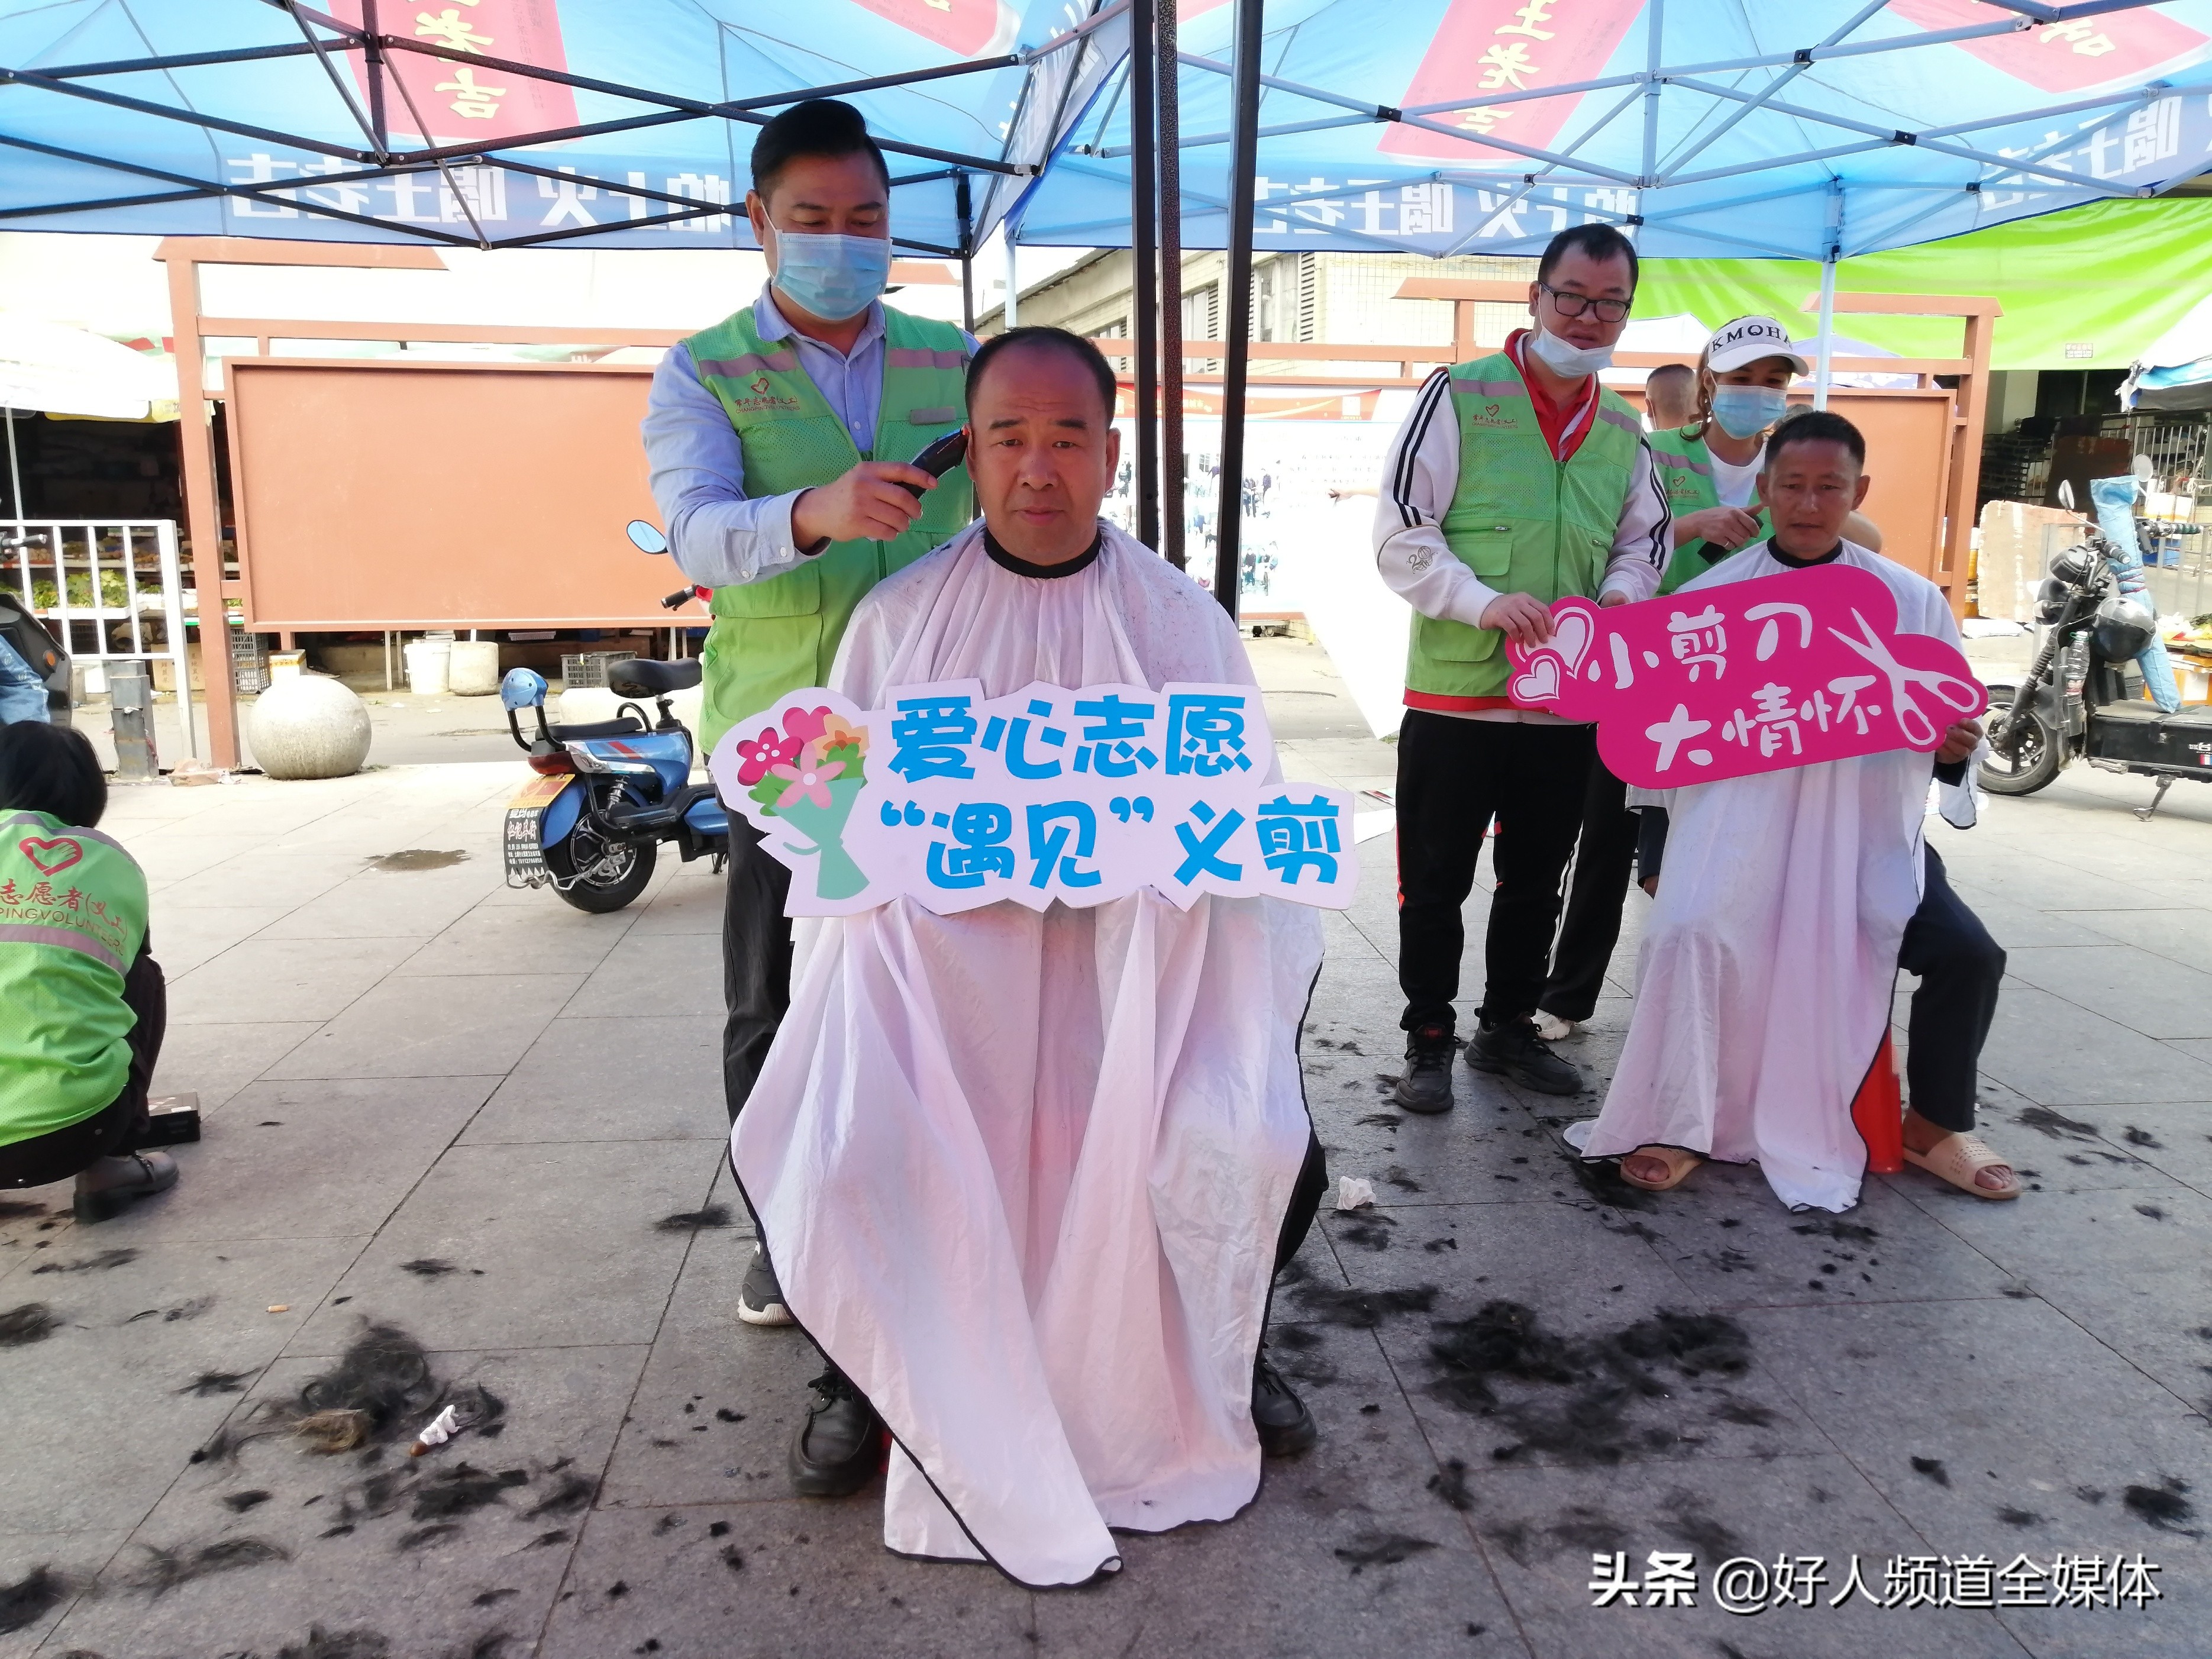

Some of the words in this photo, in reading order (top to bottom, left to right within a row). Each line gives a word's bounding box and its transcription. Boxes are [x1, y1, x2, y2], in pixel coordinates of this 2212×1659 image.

[1587, 602, 1813, 689] 小剪刀
[888, 694, 1252, 783] 爱心志愿
[1645, 674, 1882, 773] 大情怀
